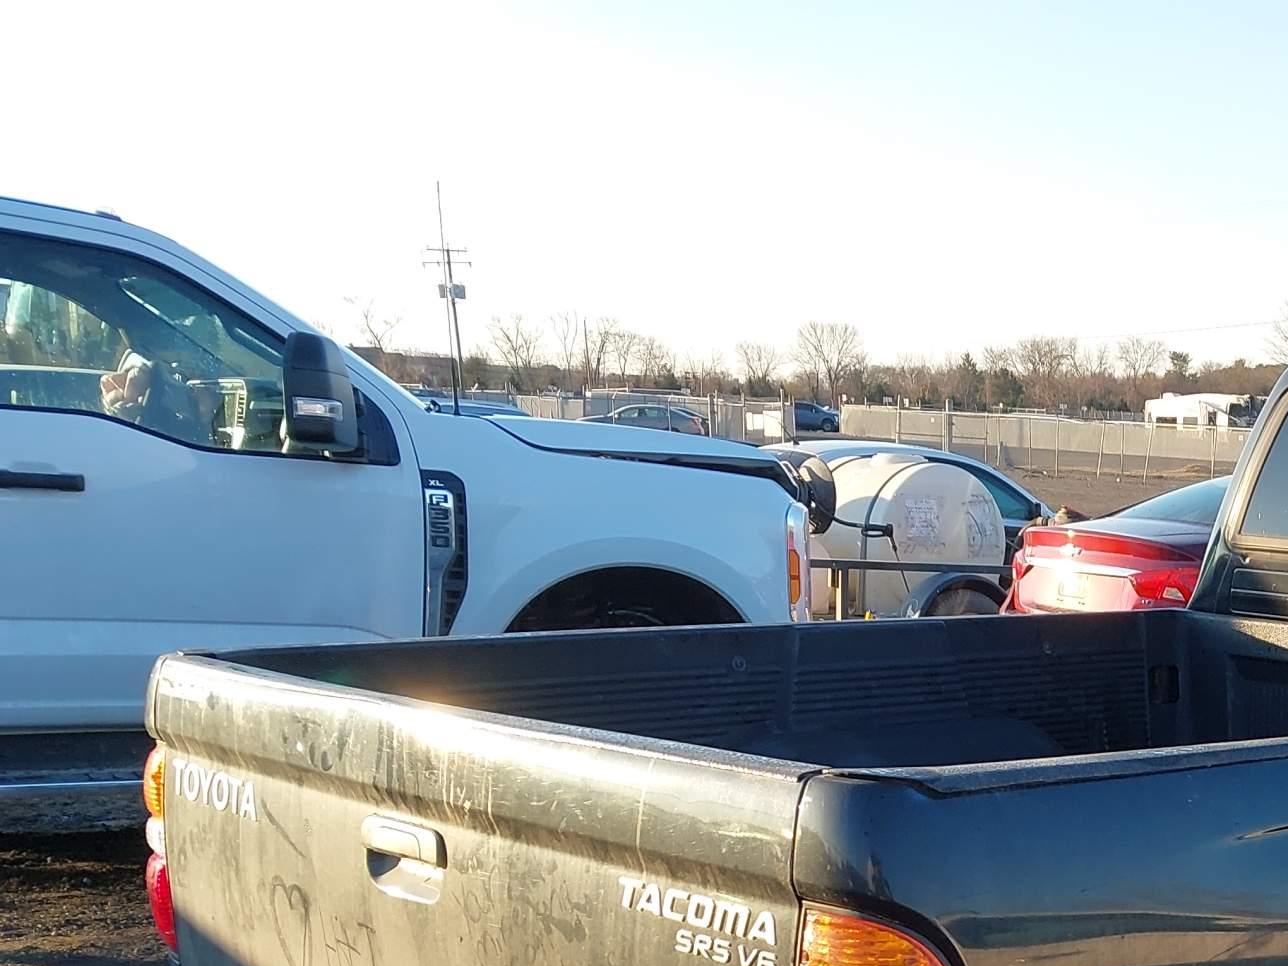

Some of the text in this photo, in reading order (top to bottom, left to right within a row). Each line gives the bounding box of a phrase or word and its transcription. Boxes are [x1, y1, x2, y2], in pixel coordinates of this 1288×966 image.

[428, 479, 445, 487] XL
[172, 758, 258, 823] TOYOTA
[618, 876, 777, 946] TACOMA
[674, 928, 732, 965] SR5
